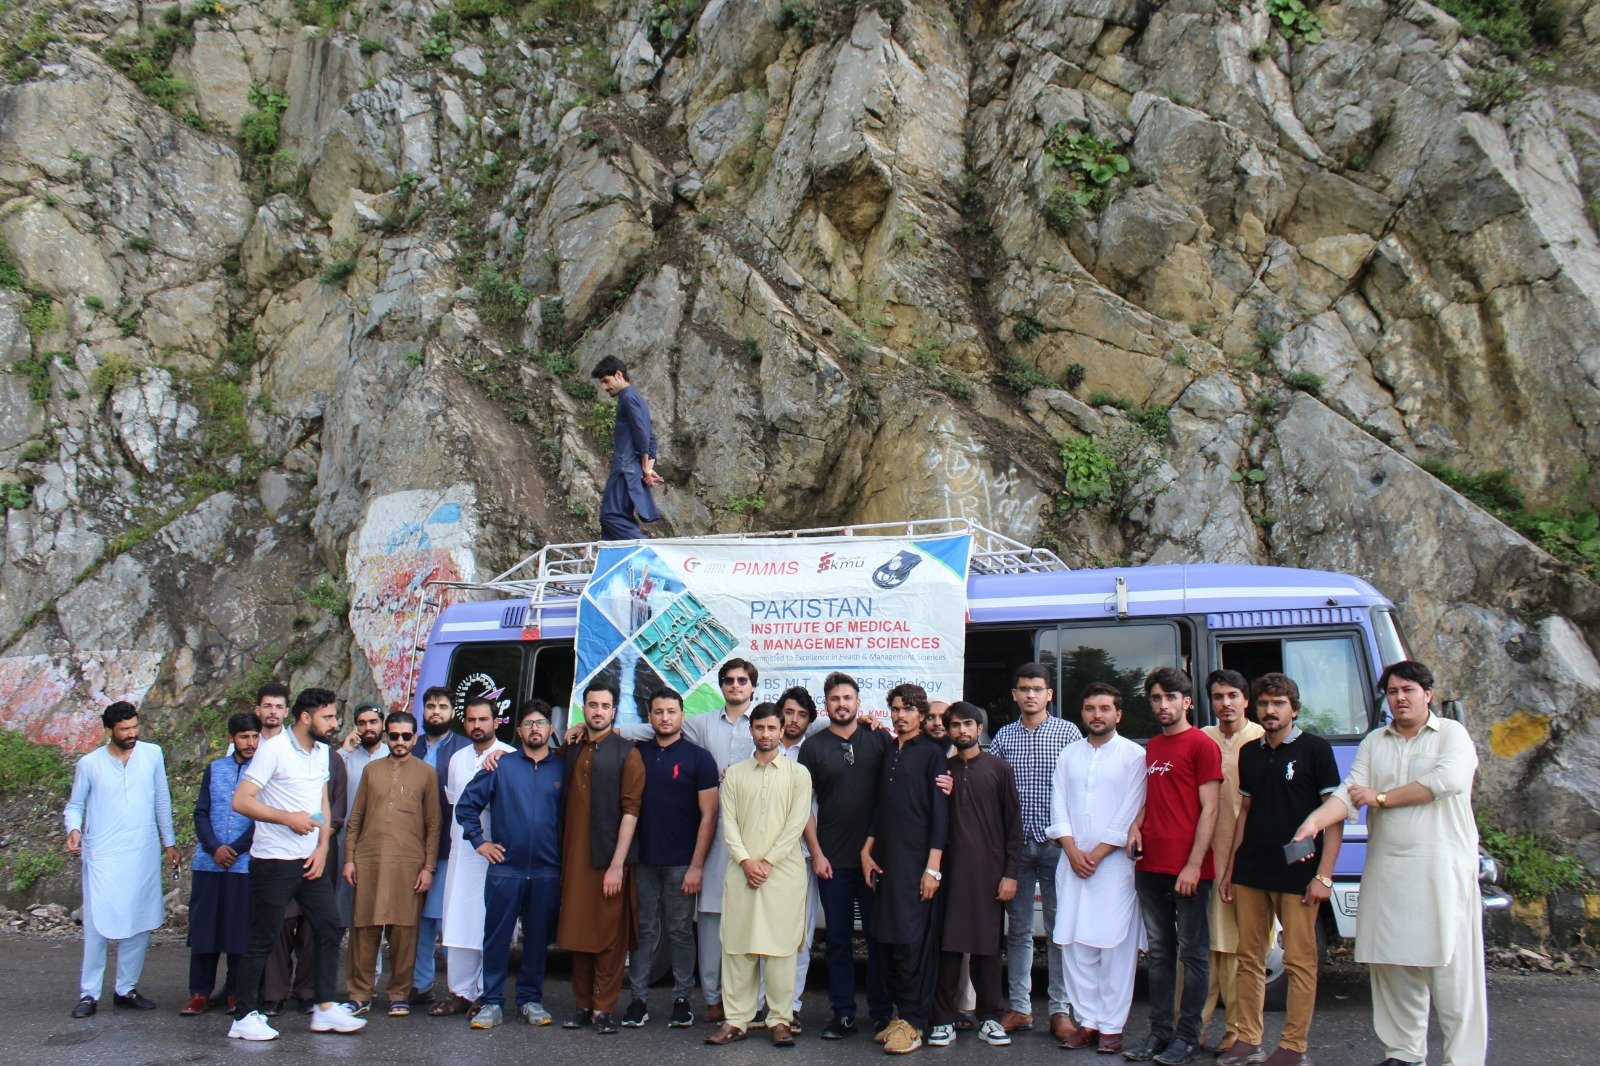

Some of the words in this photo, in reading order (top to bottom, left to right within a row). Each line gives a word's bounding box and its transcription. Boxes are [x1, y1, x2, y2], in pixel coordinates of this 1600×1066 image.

[732, 561, 799, 575] PIMMS
[830, 559, 865, 570] kmu
[750, 597, 872, 619] PAKISTAN
[751, 622, 820, 635] INSTITUTE
[824, 621, 843, 633] OF
[848, 620, 911, 633] MEDICAL
[750, 639, 759, 651] &
[763, 637, 863, 651] MANAGEMENT
[867, 637, 940, 649] SCIENCES
[749, 654, 784, 662] Committed
[869, 653, 915, 661] Management
[764, 678, 781, 690] BS
[857, 677, 873, 689] BS
